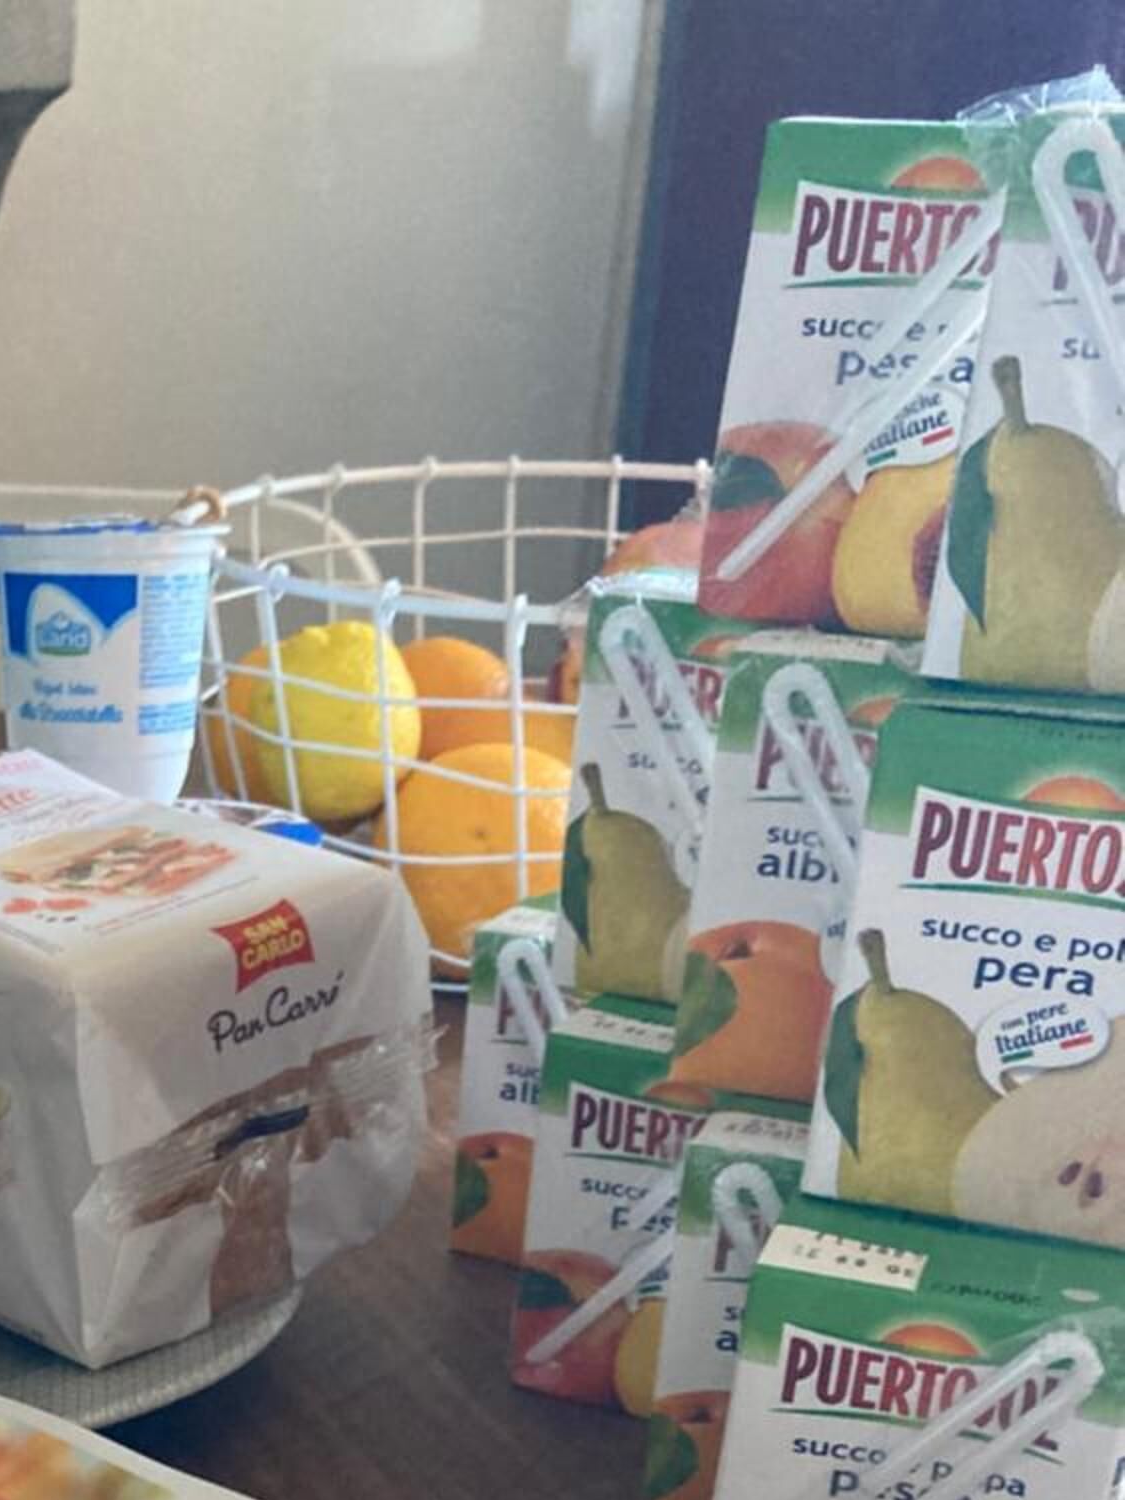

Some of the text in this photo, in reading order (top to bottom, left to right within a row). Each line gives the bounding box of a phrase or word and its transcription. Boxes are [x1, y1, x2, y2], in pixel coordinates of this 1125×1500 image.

[242, 929, 306, 970] CARLO
[922, 918, 1022, 948] succo
[1034, 934, 1057, 953] e
[973, 957, 1095, 997] pera
[995, 1018, 1088, 1054] Italiane
